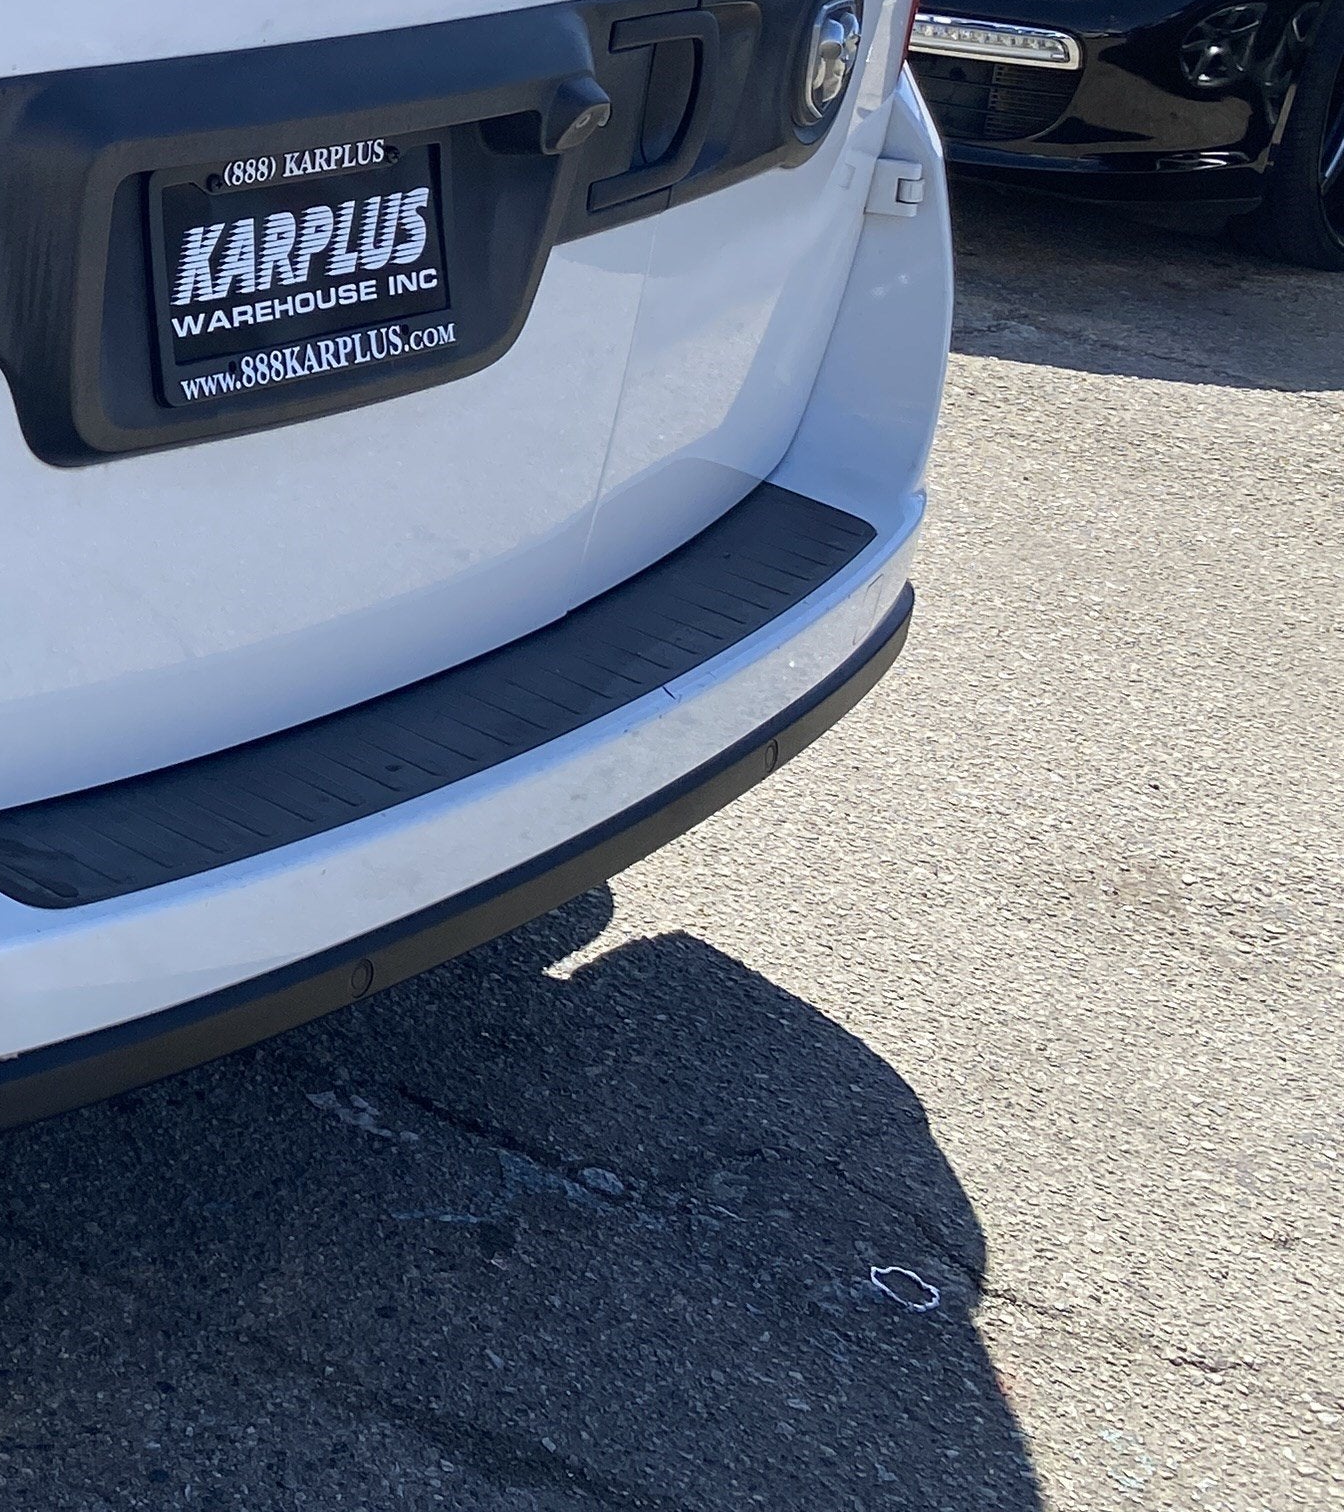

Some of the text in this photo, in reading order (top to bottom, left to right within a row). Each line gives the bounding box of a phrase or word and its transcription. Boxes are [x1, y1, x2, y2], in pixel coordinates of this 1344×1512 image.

[224, 139, 385, 187] (888) KARPLUS
[170, 188, 430, 306] KARPLUS
[171, 268, 438, 338] WAREHOUSE INC
